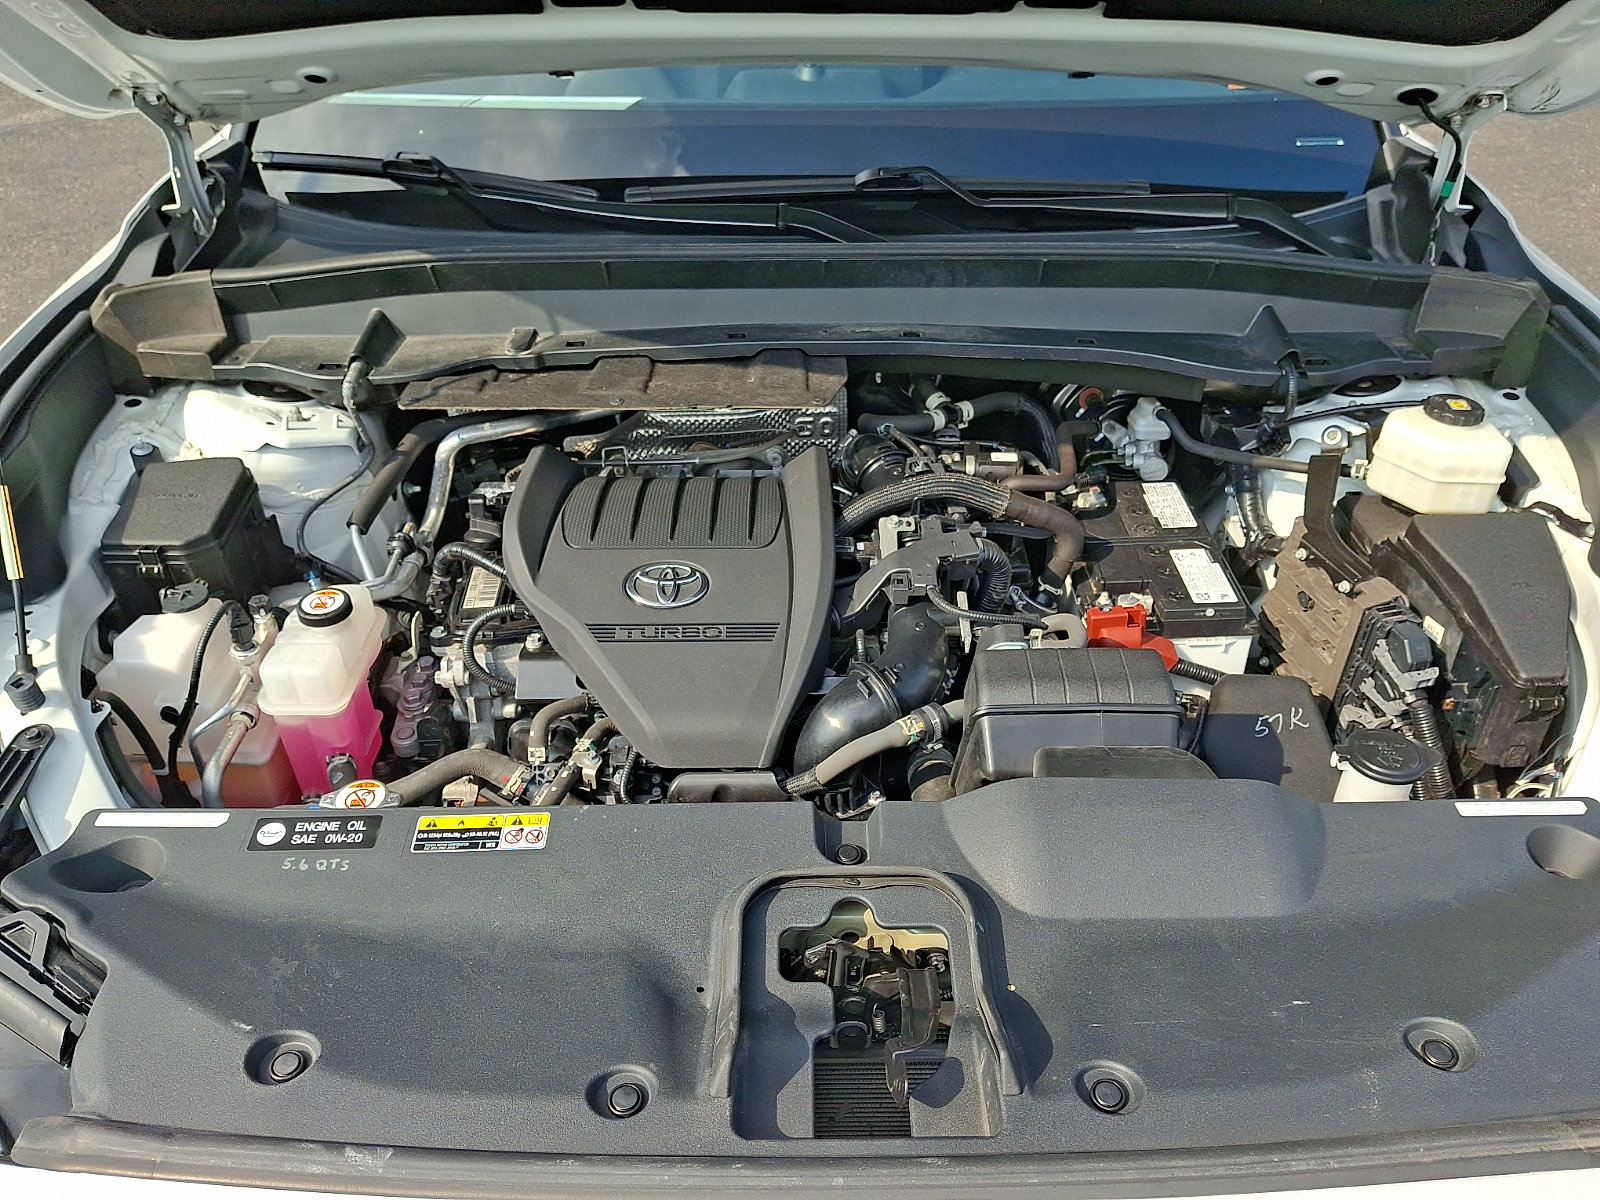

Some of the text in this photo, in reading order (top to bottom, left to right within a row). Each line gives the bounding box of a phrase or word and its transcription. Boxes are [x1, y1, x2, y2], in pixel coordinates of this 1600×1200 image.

[619, 627, 723, 639] TURBO
[295, 820, 367, 832] ENGINE OIL
[291, 832, 364, 845] SAE 0W-20
[281, 856, 350, 871] 5.6 QTS
